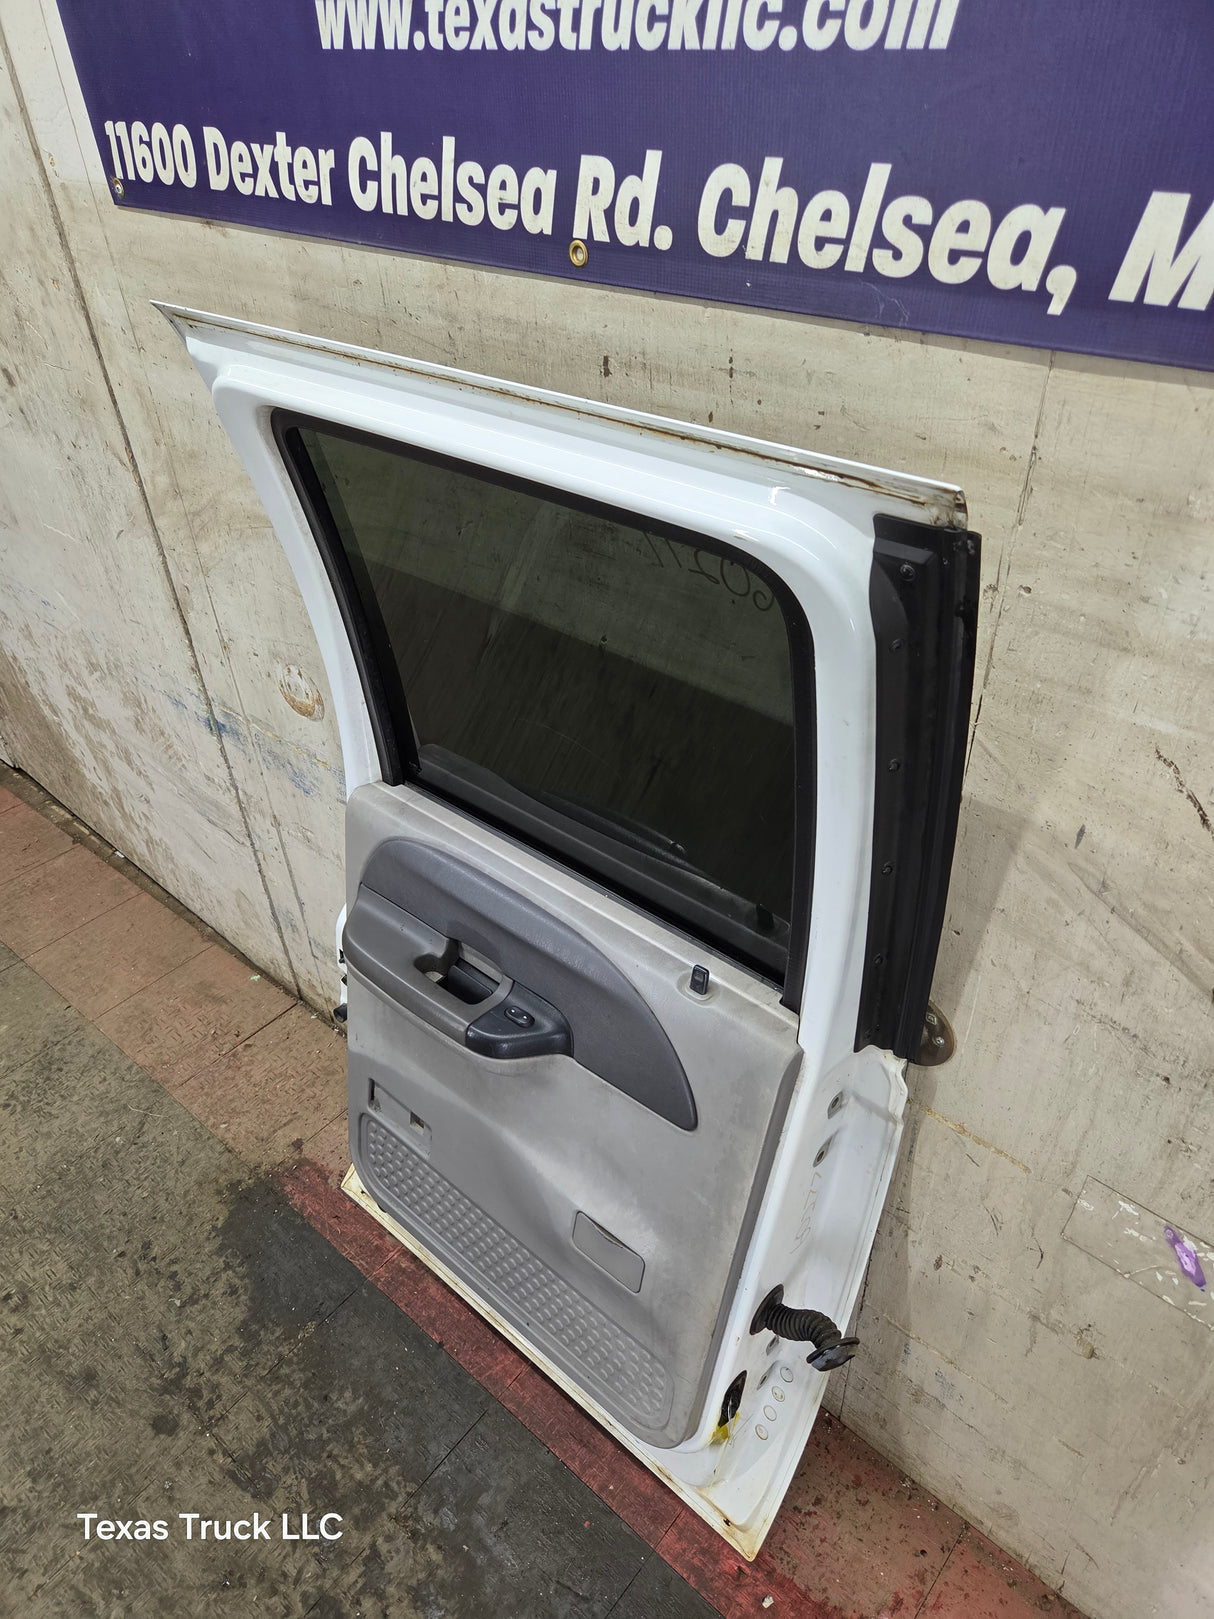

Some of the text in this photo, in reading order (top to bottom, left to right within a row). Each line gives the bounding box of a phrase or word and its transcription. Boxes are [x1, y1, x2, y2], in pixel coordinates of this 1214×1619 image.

[314, 0, 960, 51] www.texastruckllc.com
[103, 120, 197, 188] 11600
[203, 126, 336, 206] Dexter
[347, 131, 557, 236] Chelsea
[572, 149, 673, 251] Rd.
[697, 156, 1078, 316] Chelsea,
